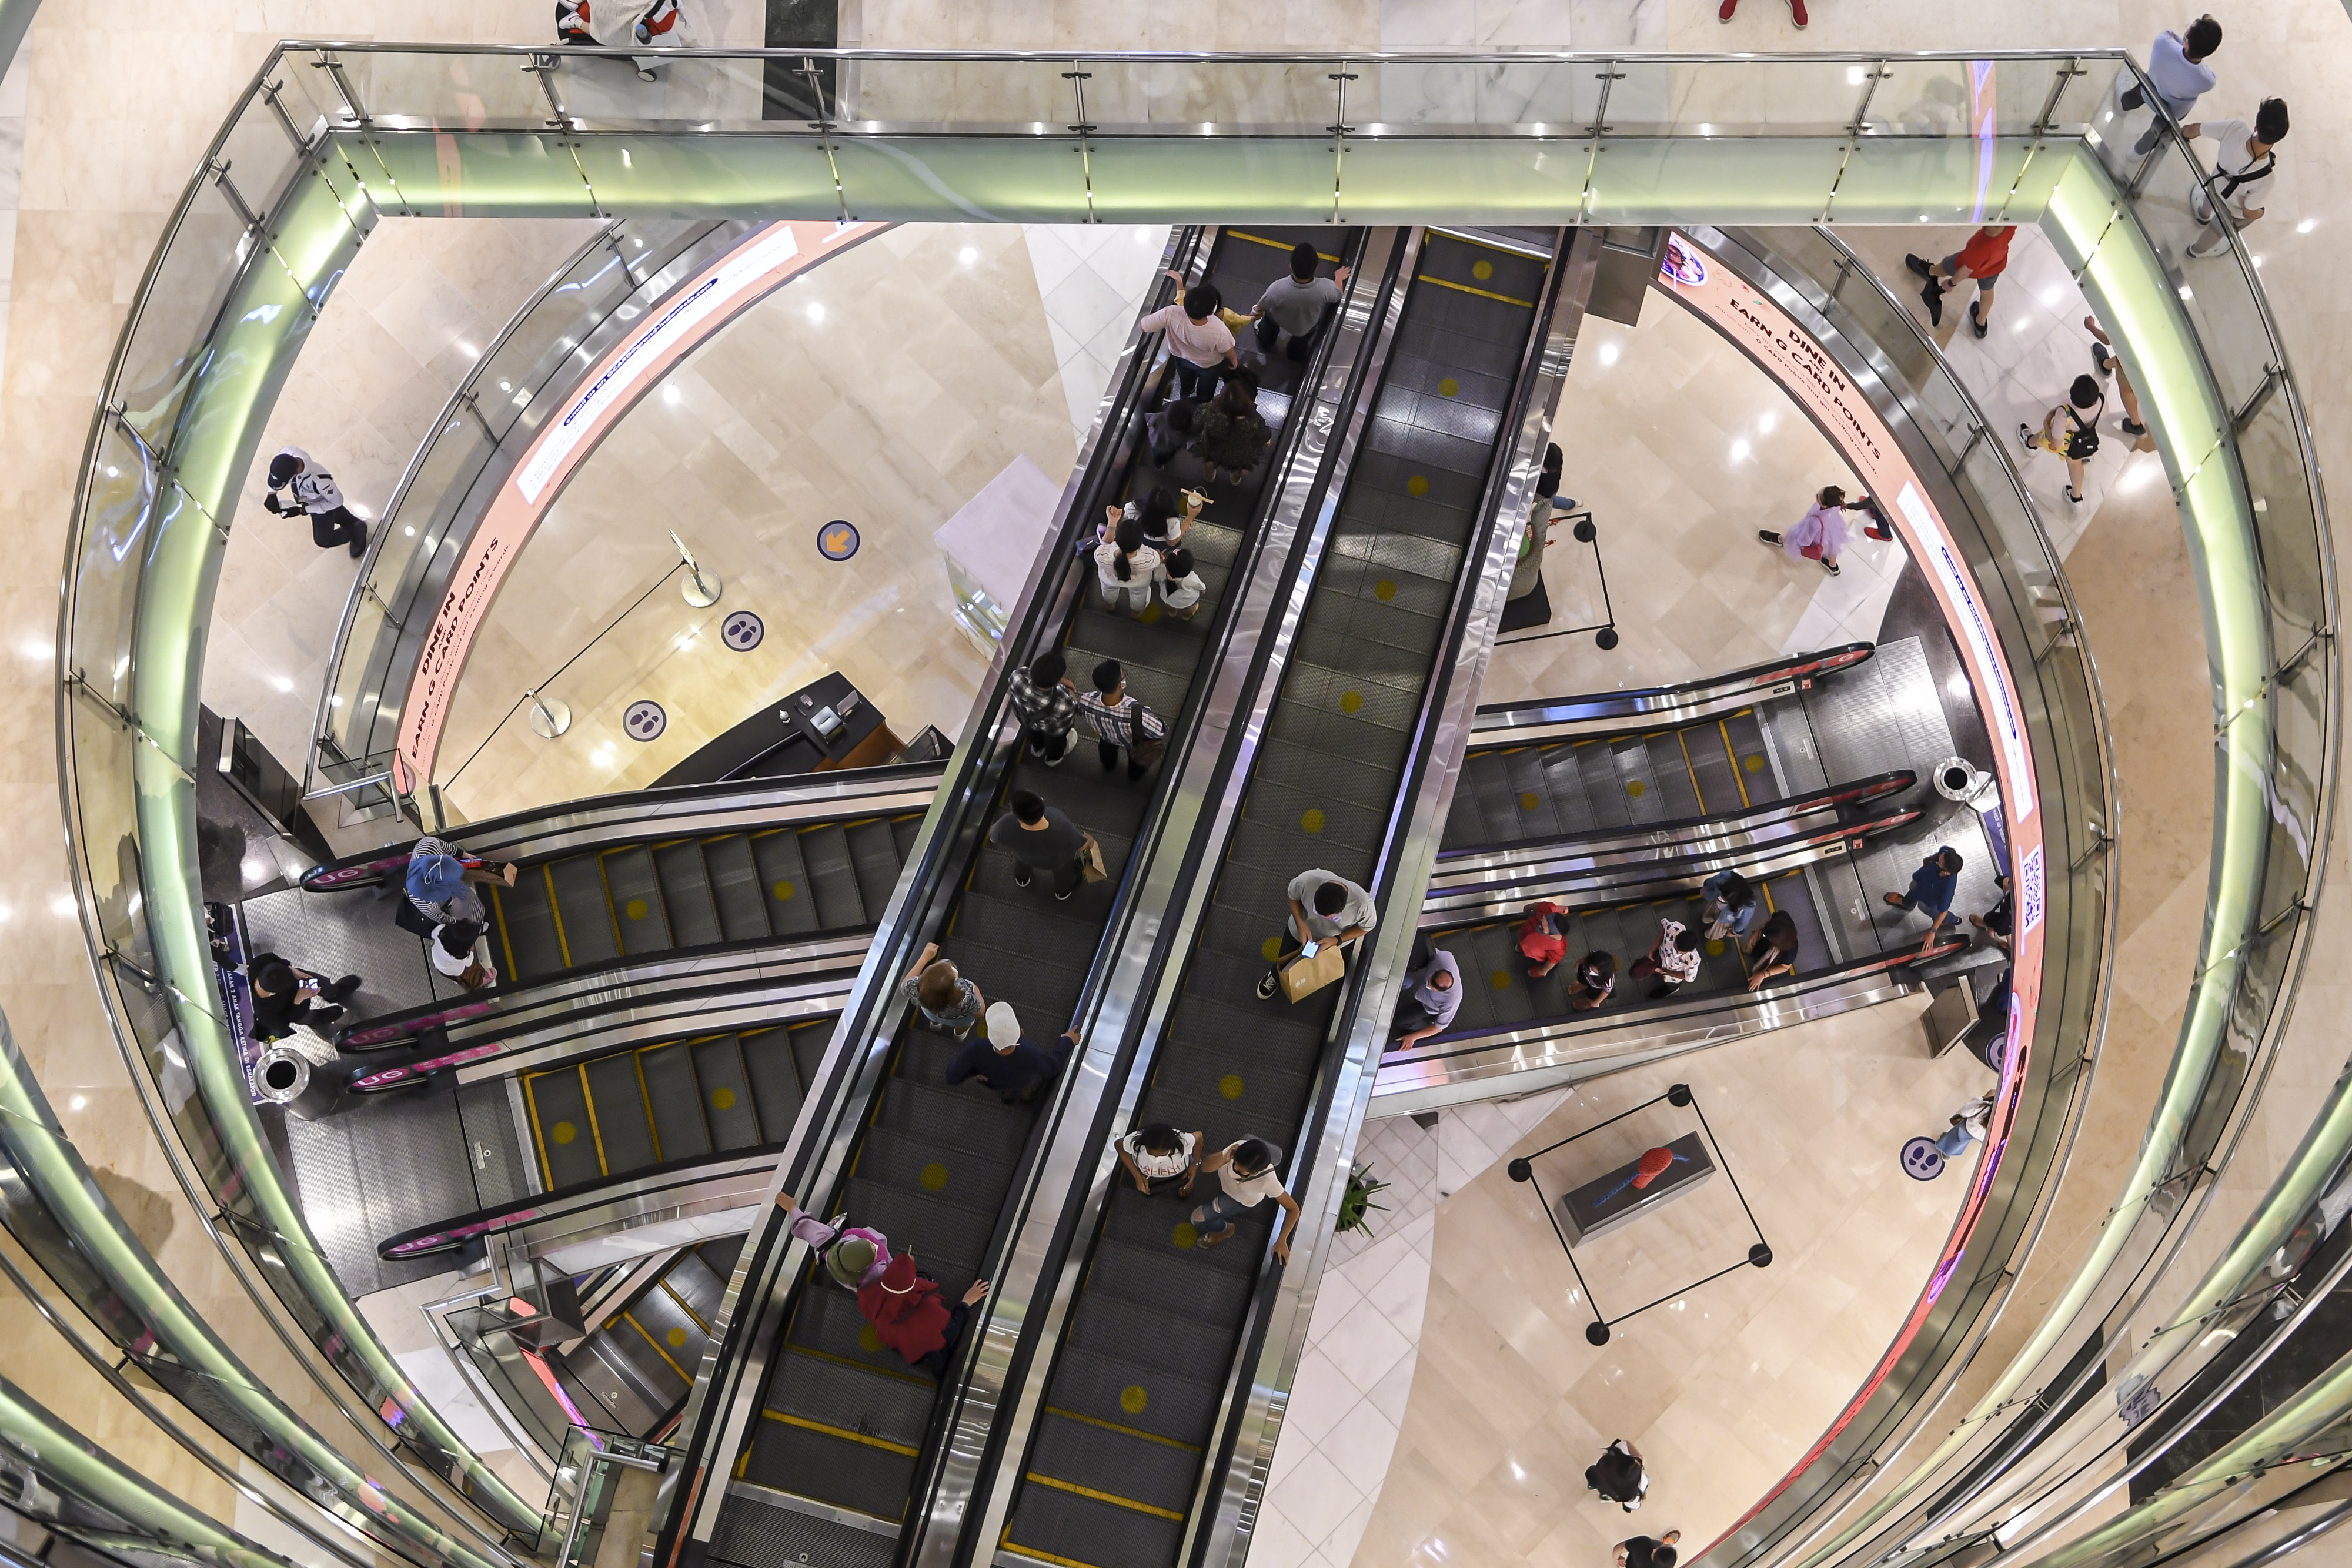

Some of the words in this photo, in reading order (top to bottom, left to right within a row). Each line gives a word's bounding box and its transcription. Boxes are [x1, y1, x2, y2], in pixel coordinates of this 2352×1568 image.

[1730, 298, 1772, 337] EARN
[1776, 338, 1788, 351] G
[1791, 352, 1831, 394] CARD
[1833, 396, 1881, 460] POINTS
[1788, 329, 1827, 370] DINE
[1828, 370, 1845, 392] IN
[1808, 359, 1822, 374] AND
[564, 398, 587, 424] e-mail
[586, 389, 596, 399] us
[1763, 345, 1783, 363] CARD
[1784, 363, 1805, 383] Points
[1806, 385, 1819, 399] and
[1820, 400, 1830, 412] get
[1831, 413, 1853, 442] exciting
[412, 700, 429, 759] EARN
[429, 679, 436, 696] G
[435, 616, 458, 674] CARD
[458, 537, 499, 613] POINTS
[422, 620, 444, 676] DINE
[443, 591, 456, 618] IN
[439, 629, 447, 650] AND
[434, 690, 443, 716] CARD
[454, 637, 462, 656] and
[312, 867, 359, 884] UG
[236, 1012, 244, 1035] TANGGA
[246, 1065, 256, 1096] ESKALATOR
[348, 1028, 395, 1044] UG
[357, 1070, 403, 1085] UG
[392, 1237, 438, 1252] UG
